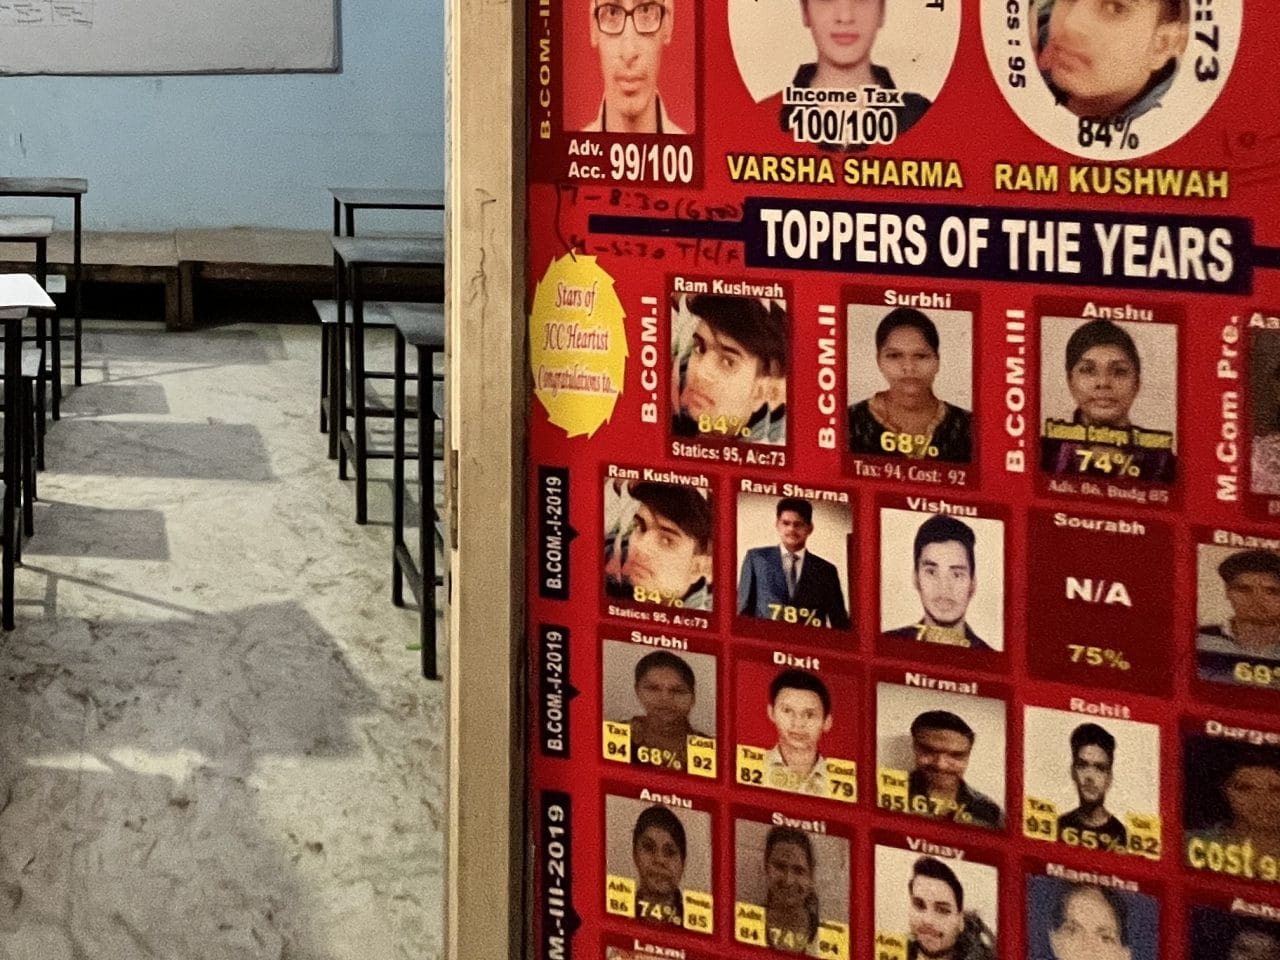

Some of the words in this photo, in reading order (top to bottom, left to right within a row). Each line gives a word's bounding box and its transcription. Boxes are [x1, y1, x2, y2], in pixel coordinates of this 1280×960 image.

[1008, 56, 1026, 89] 95
[785, 86, 858, 104] Income
[864, 89, 901, 105] Tax
[790, 109, 895, 143] 100/100
[1078, 117, 1139, 150] 84%
[568, 140, 604, 157] Adv.
[568, 162, 606, 180] Acc.
[609, 143, 694, 183] 99/100
[727, 155, 835, 184] VARSHA
[844, 159, 963, 189] SHARMA
[994, 163, 1058, 192] RAM
[1069, 166, 1229, 199] KUSHWAH
[760, 209, 928, 267] TOPPERS
[939, 216, 989, 269] OF
[1002, 219, 1081, 274] THE
[1094, 222, 1234, 282] YEARS
[555, 281, 582, 308] Stars
[585, 281, 598, 316] of
[674, 277, 708, 293] Ram
[712, 280, 784, 298] Kushwah
[883, 289, 952, 308] Surbhi
[1082, 302, 1153, 322] Anshu
[641, 296, 658, 424] B.COM.I
[818, 304, 836, 449] B.COM.II
[1005, 309, 1025, 473] B.COM.III
[698, 414, 752, 438] 84%
[672, 441, 719, 460] Statics:
[880, 431, 940, 458] 68%
[1216, 391, 1238, 502] M.Com
[854, 460, 881, 477] Tax:
[908, 466, 942, 483] Cost:
[948, 470, 966, 485] 92
[1075, 449, 1141, 477] 74%
[608, 464, 640, 481] Ram
[643, 467, 709, 488] Kushwah
[741, 479, 777, 495] Ravi
[783, 484, 849, 503] Sharma
[906, 496, 978, 517] Vishnu
[1053, 512, 1146, 536] Sourabh
[633, 586, 684, 608] 84%
[1065, 576, 1132, 607] N/A
[768, 604, 822, 628] 78%
[631, 631, 688, 650] Surbhi
[773, 652, 820, 671] Dixit
[1068, 643, 1131, 671] 75%
[905, 672, 978, 695] Nirmal
[1070, 697, 1131, 719] Rohit
[607, 724, 628, 737] Tax
[607, 741, 627, 757] 94
[637, 746, 682, 770] 68%
[693, 755, 712, 771] 92
[740, 767, 763, 784] 82
[640, 788, 692, 809] Anshu
[830, 779, 854, 797] 79
[772, 813, 826, 834] Swati
[906, 835, 965, 860] Vinay
[1046, 862, 1140, 892] Manisha
[638, 900, 682, 926] 74%
[633, 939, 686, 960] Laxmi
